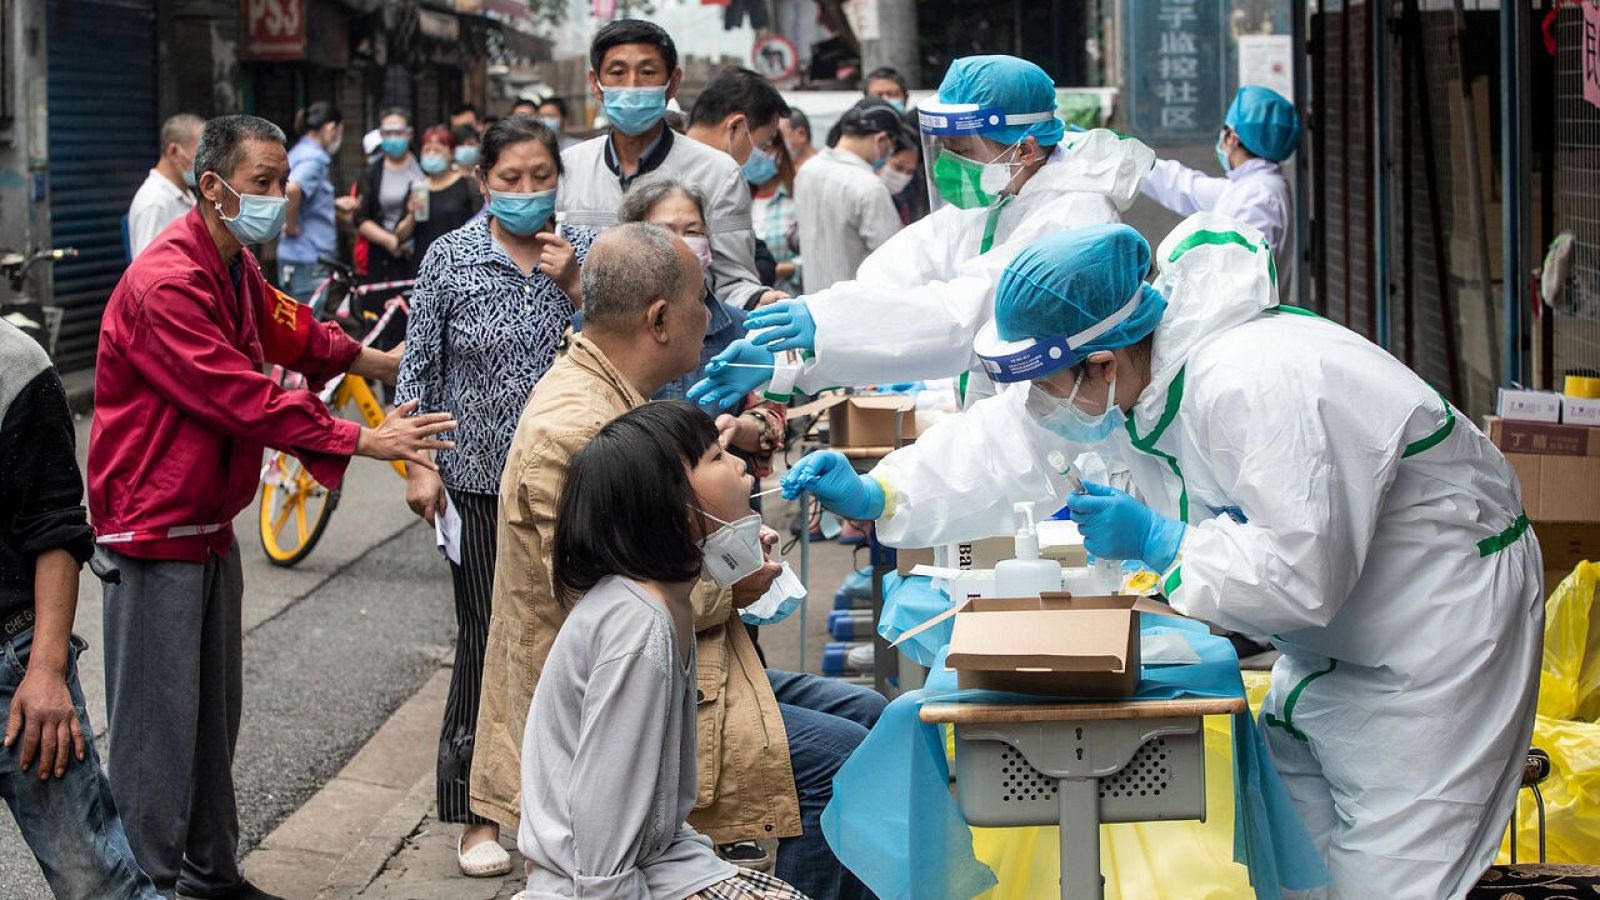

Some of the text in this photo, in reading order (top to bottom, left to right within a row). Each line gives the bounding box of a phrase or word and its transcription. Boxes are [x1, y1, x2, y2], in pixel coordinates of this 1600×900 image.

[248, 0, 300, 36] PS3
[1157, 0, 1198, 128] 子监控社区
[959, 544, 972, 570] Ba
[5, 615, 25, 634] CHE
